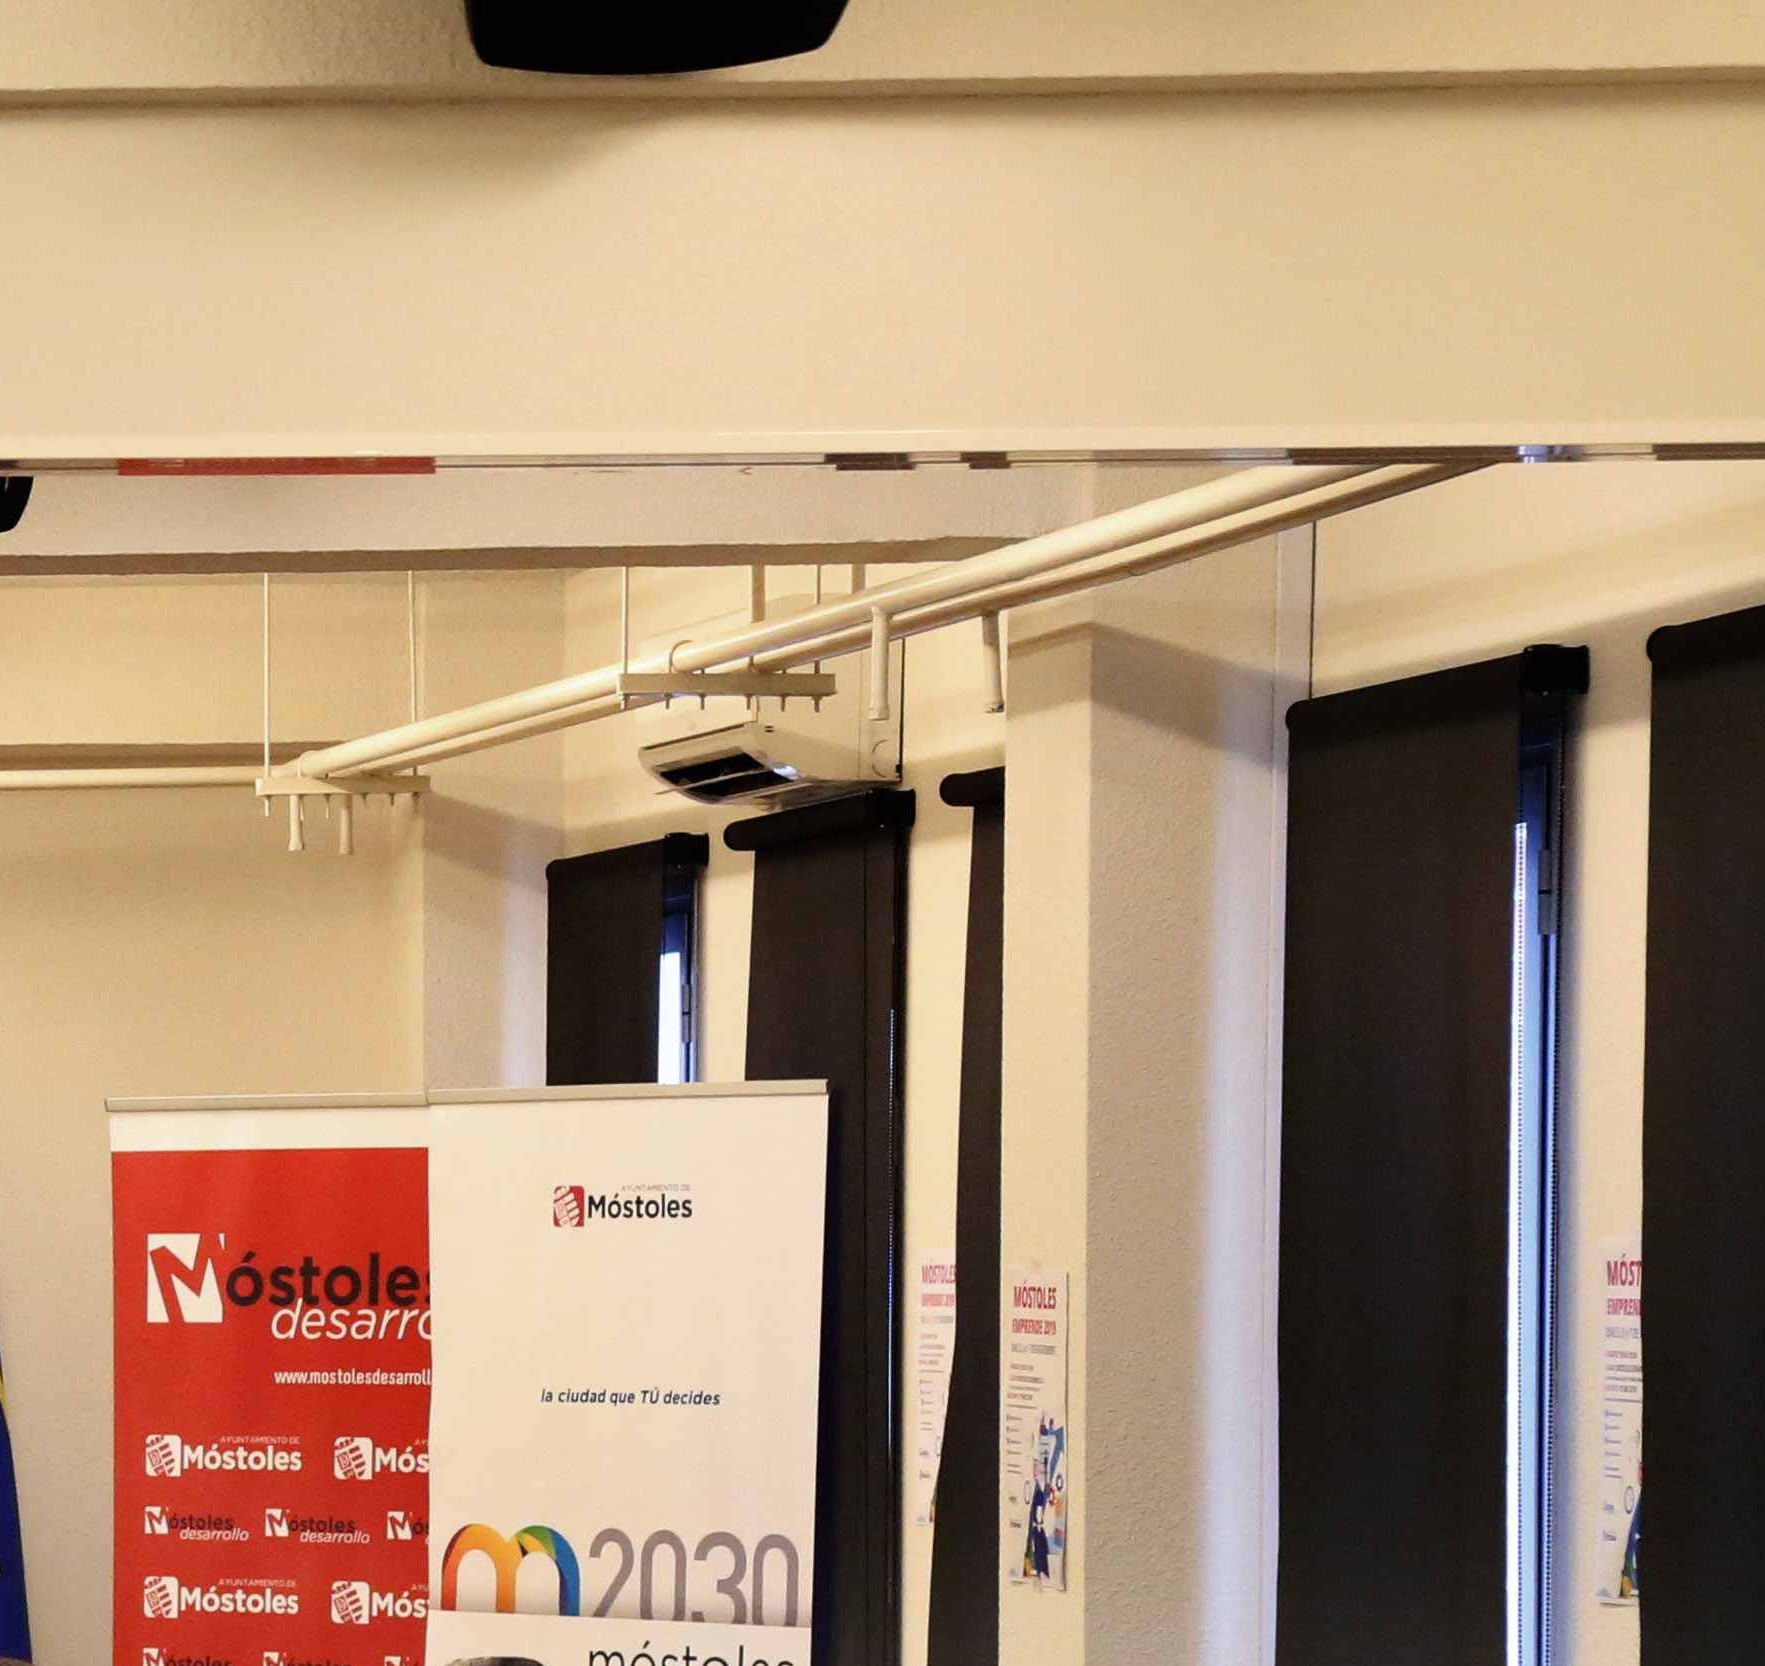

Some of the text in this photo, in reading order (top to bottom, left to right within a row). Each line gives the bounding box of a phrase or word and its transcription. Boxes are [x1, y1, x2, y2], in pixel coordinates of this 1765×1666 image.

[587, 1194, 692, 1219] Móstoles
[1014, 1279, 1056, 1309] MÓSTOLES
[541, 1386, 720, 1405] la ciudad que TÚ decides
[220, 1435, 288, 1444] AYUNTAMIENTO
[183, 1443, 303, 1471] Móstoles
[180, 1526, 249, 1542] desarrollo
[300, 1529, 370, 1544] desarrollo
[180, 1586, 299, 1614] Móstoles
